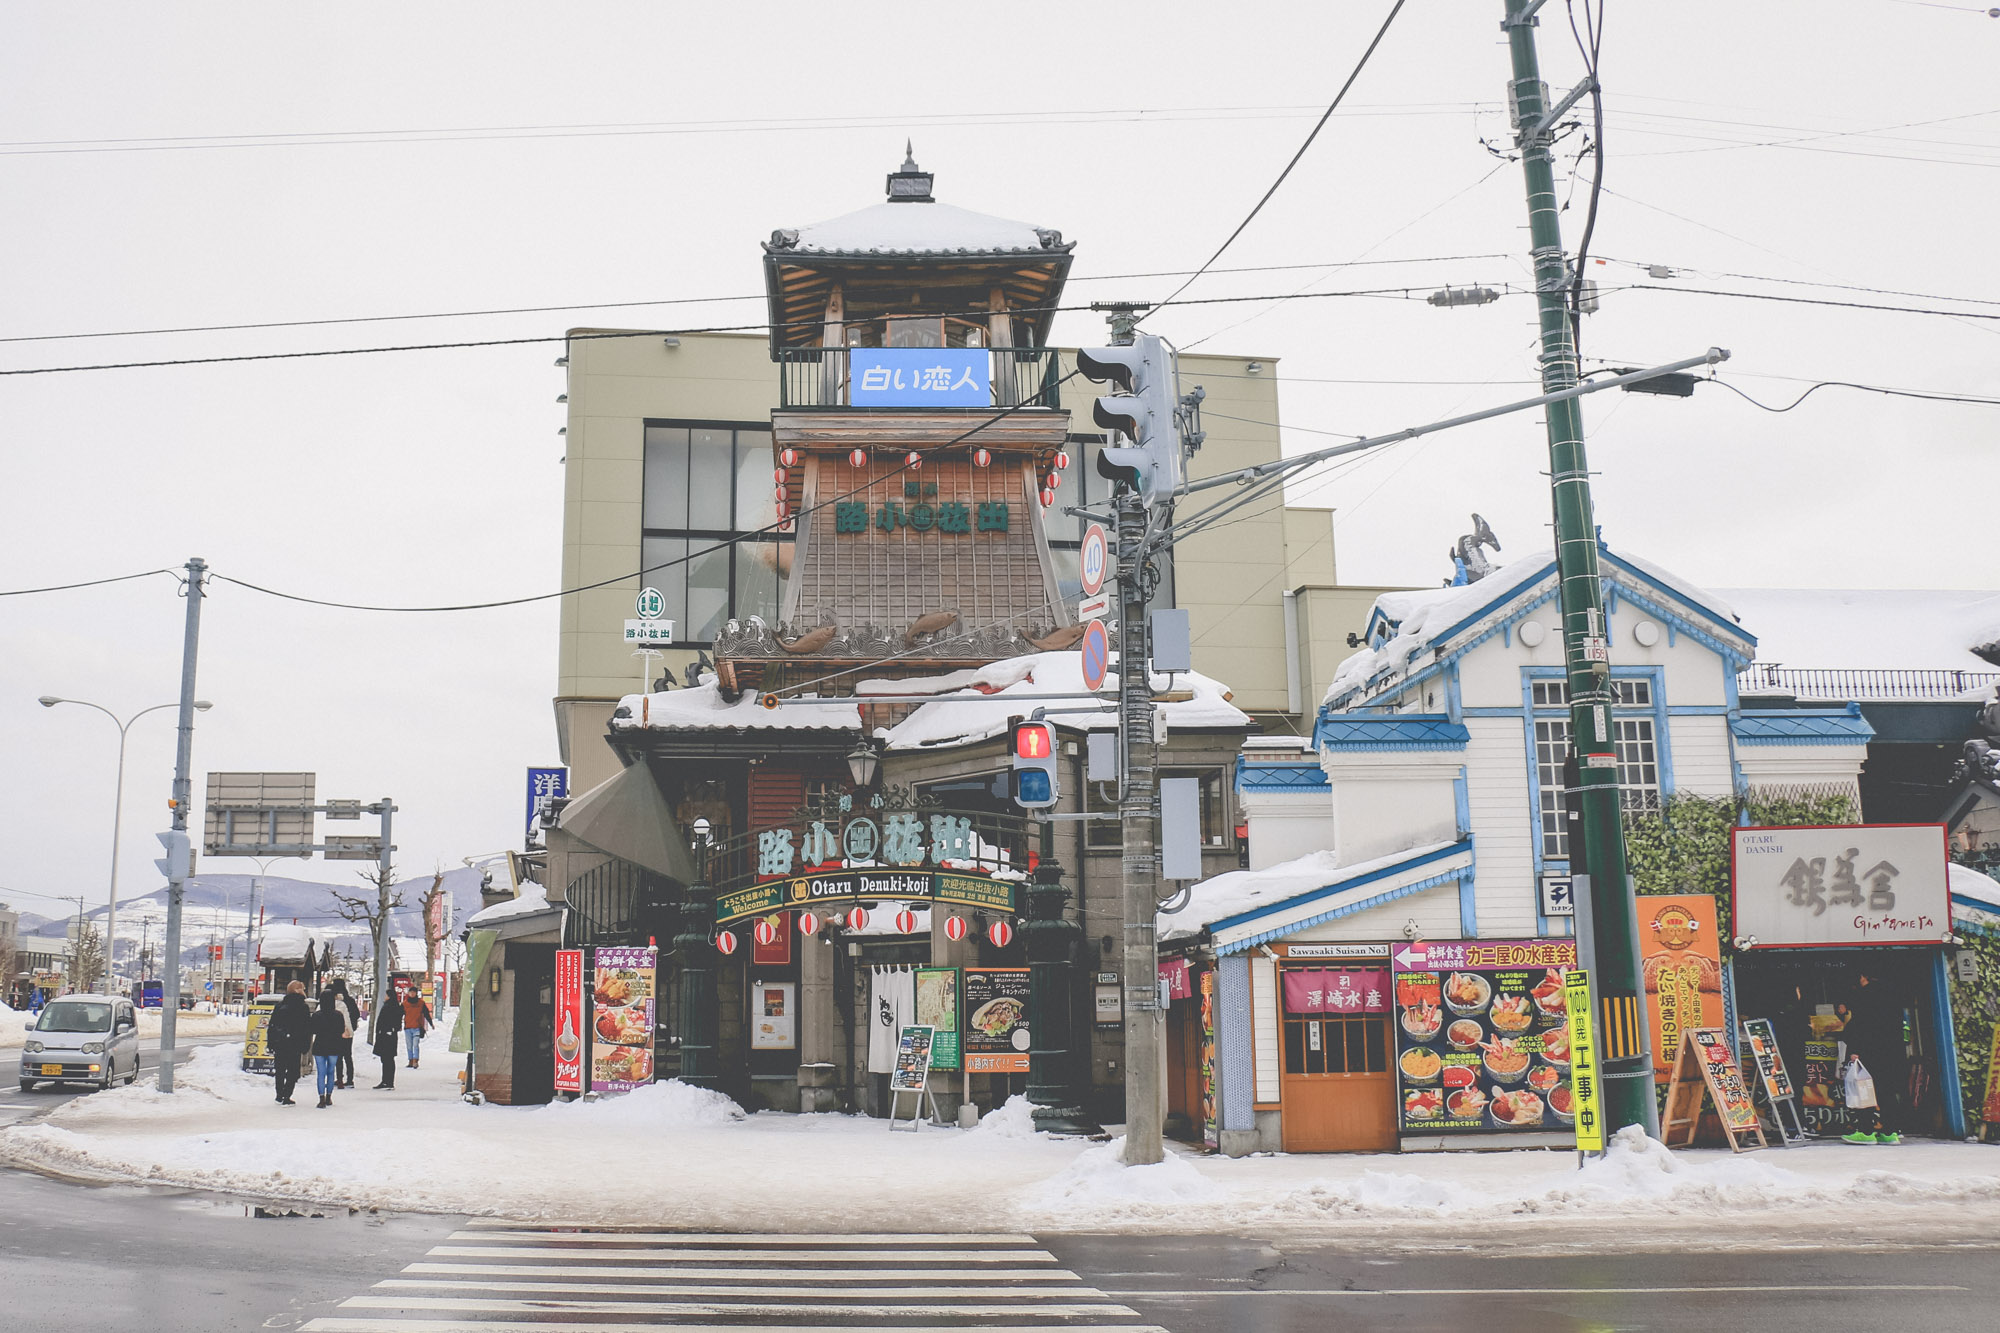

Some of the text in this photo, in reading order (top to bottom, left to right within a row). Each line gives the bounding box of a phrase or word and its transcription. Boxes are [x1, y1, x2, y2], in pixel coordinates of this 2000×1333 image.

[861, 365, 979, 391] 白い恋人
[1087, 544, 1100, 575] 40
[1743, 836, 1776, 844] OTARU
[1746, 846, 1783, 854] DANISH
[812, 876, 929, 896] Otaru Denuki-koji
[732, 898, 769, 914] Welcome
[1291, 946, 1387, 955] Sawasaki Suisan No3
[1427, 945, 1464, 959] 海鮮食堂
[598, 956, 653, 967] 海鮮食堂
[1306, 989, 1383, 1008] 澤崎水産
[1658, 968, 1678, 1062] たい焼きの王様
